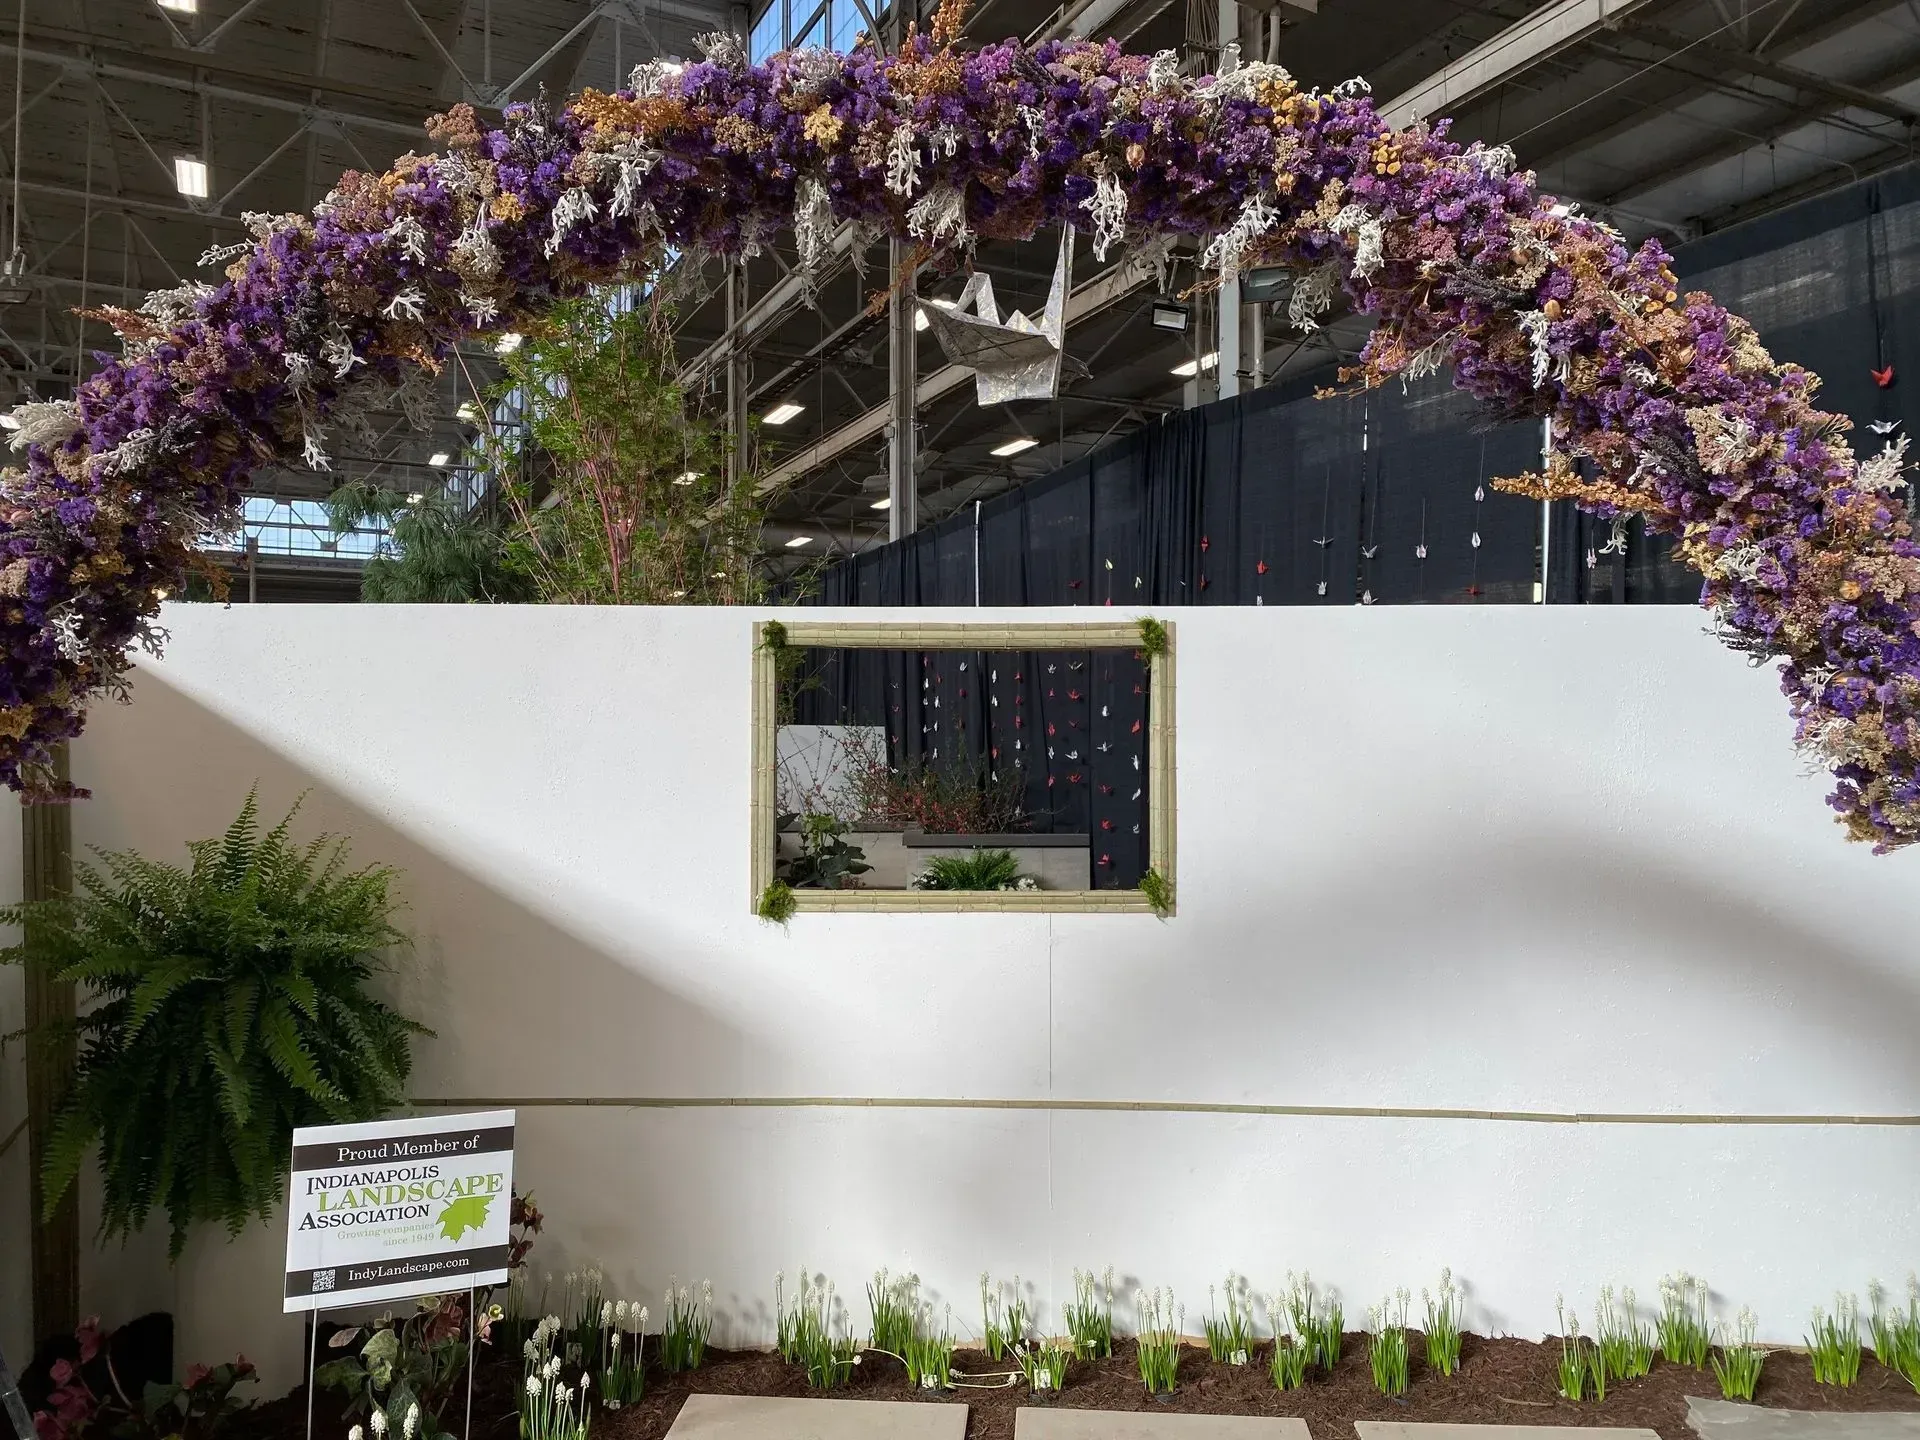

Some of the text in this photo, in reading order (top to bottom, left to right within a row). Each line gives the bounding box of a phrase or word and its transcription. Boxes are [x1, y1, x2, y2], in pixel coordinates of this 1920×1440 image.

[337, 1134, 480, 1162] Proud Member of
[306, 1165, 440, 1196] INDIANAPOLIS
[316, 1172, 504, 1213] LANDSCAPE
[298, 1204, 430, 1231] ASSOCIATION
[337, 1223, 435, 1241] Growing companies
[382, 1232, 435, 1247] since 1949
[348, 1256, 470, 1281] IndyLandscape.com
